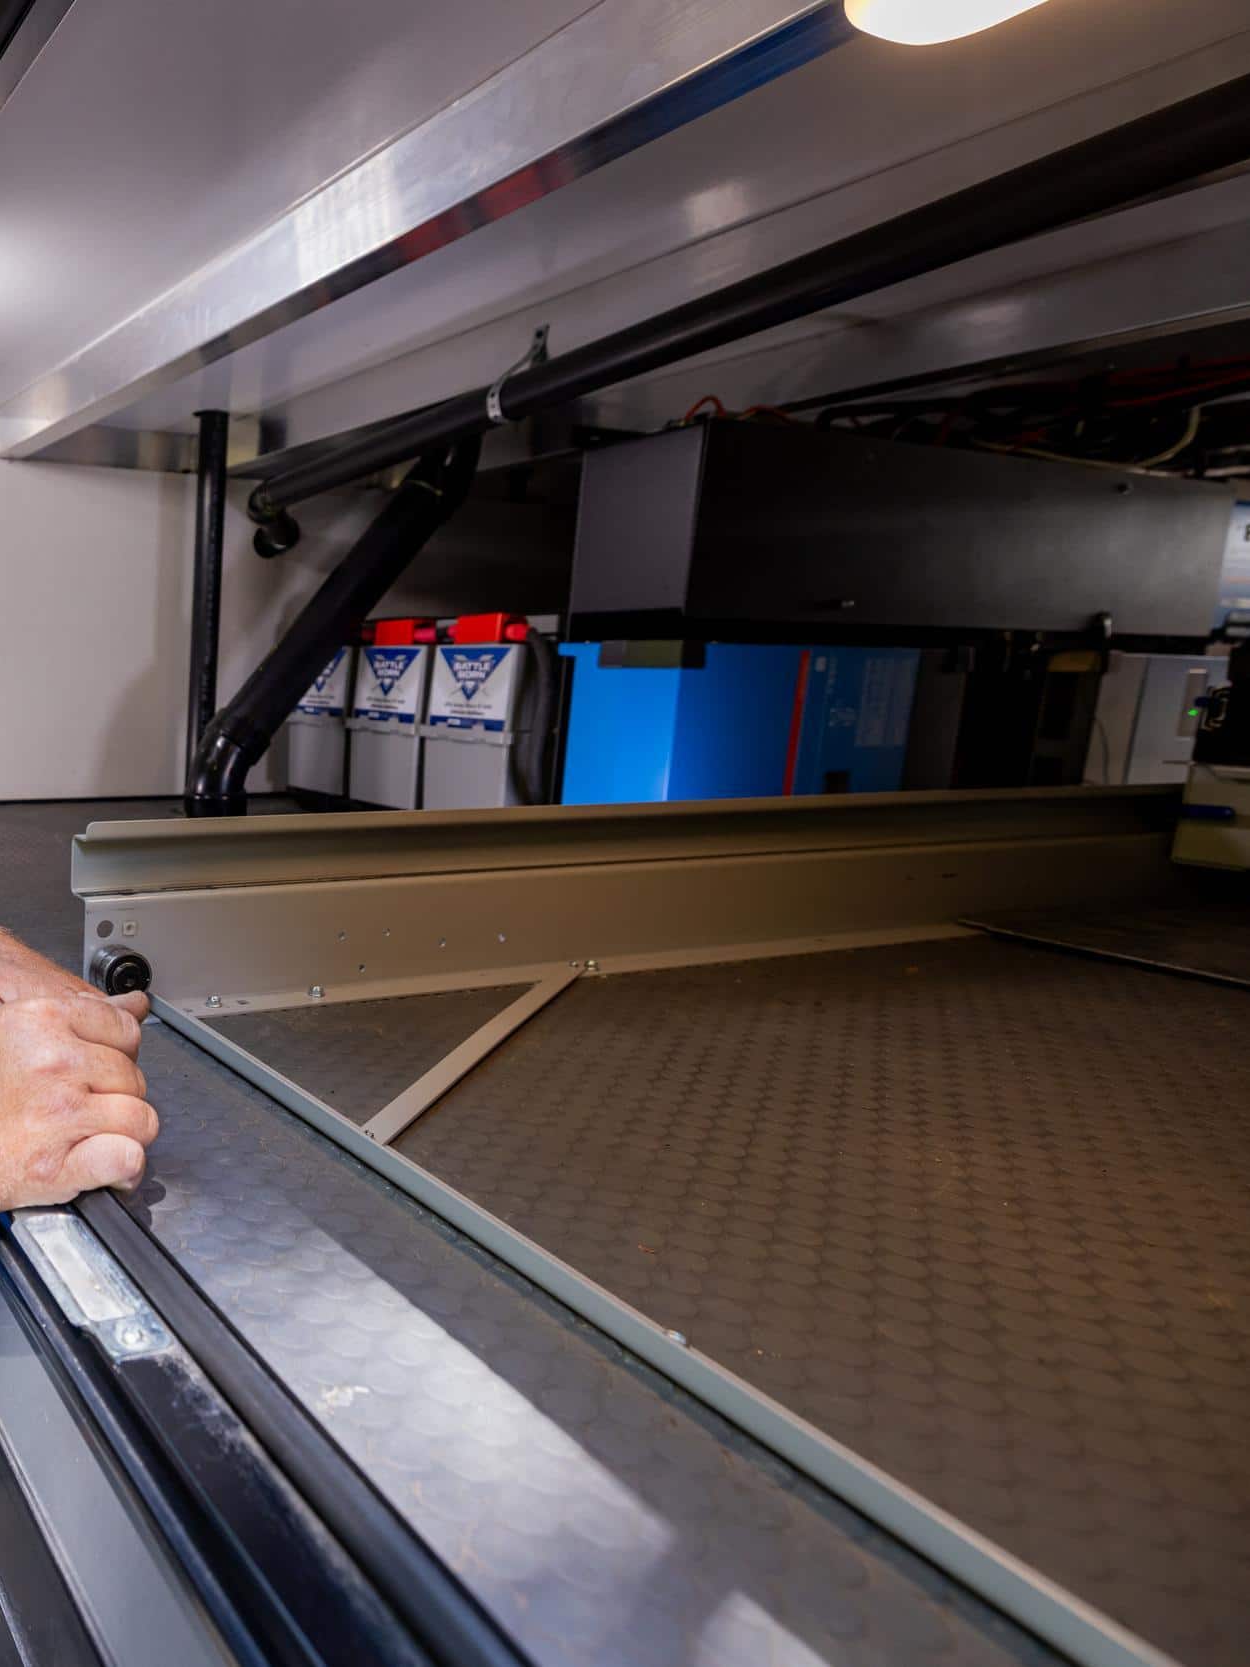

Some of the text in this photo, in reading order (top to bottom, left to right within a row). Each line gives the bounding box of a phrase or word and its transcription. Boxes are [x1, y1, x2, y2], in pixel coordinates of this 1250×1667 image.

[374, 661, 404, 670] BATTLE
[454, 662, 491, 671] BATTLE
[377, 669, 400, 677] BORN
[457, 671, 485, 679] BORN
